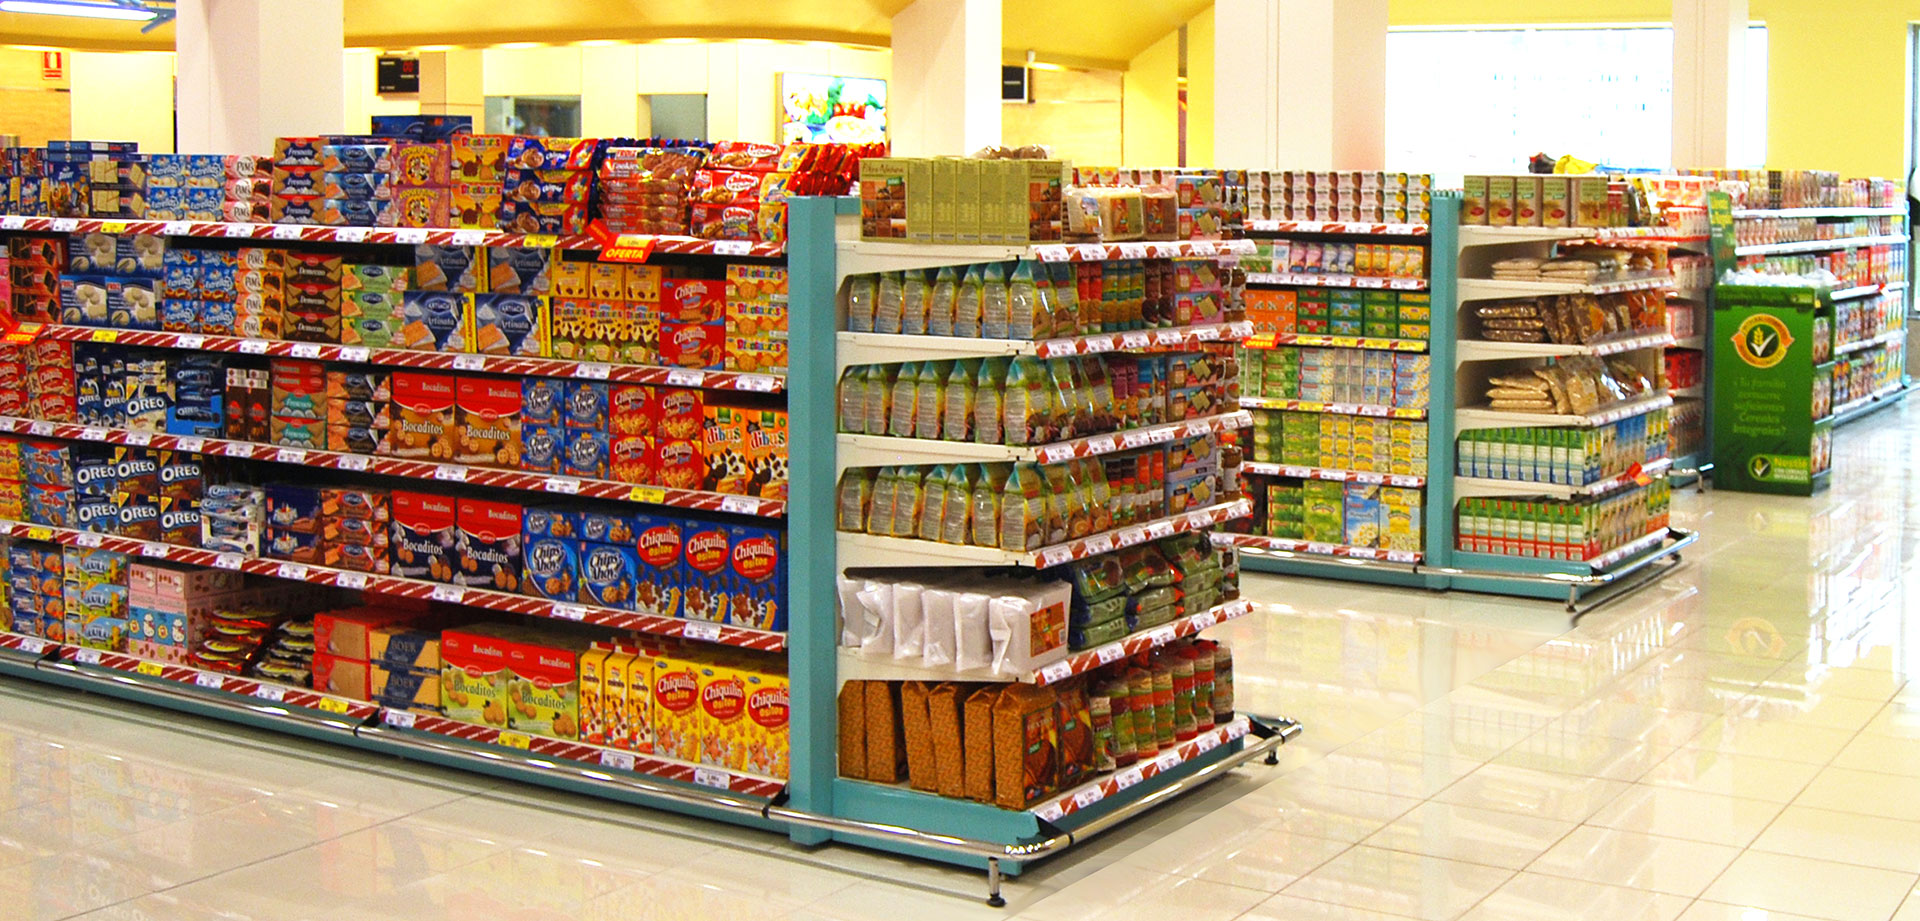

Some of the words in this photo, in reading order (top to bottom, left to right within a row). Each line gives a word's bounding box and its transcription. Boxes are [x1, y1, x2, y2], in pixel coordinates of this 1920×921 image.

[606, 248, 644, 259] OFERTA
[127, 397, 165, 415] OREO
[402, 419, 444, 435] Bocaditos
[467, 425, 510, 441] Bocaditos
[707, 426, 741, 444] dibus
[750, 430, 786, 449] dibus
[77, 467, 116, 484] OREO
[117, 461, 155, 480] OREO
[161, 465, 200, 482] OREO
[79, 505, 118, 522] OREO
[120, 506, 157, 523] OREO
[162, 512, 199, 529] OREO
[402, 538, 444, 555] Bocaditos
[640, 531, 680, 549] Chiquilin
[688, 535, 728, 554] Chiquilin
[466, 547, 509, 564] Bocaditos
[734, 541, 774, 561] Chiquilin
[453, 679, 496, 698] Bocaditos
[657, 675, 696, 693] Chiquilin
[704, 684, 743, 701] Chiquilin
[521, 692, 566, 710] Bocaditos
